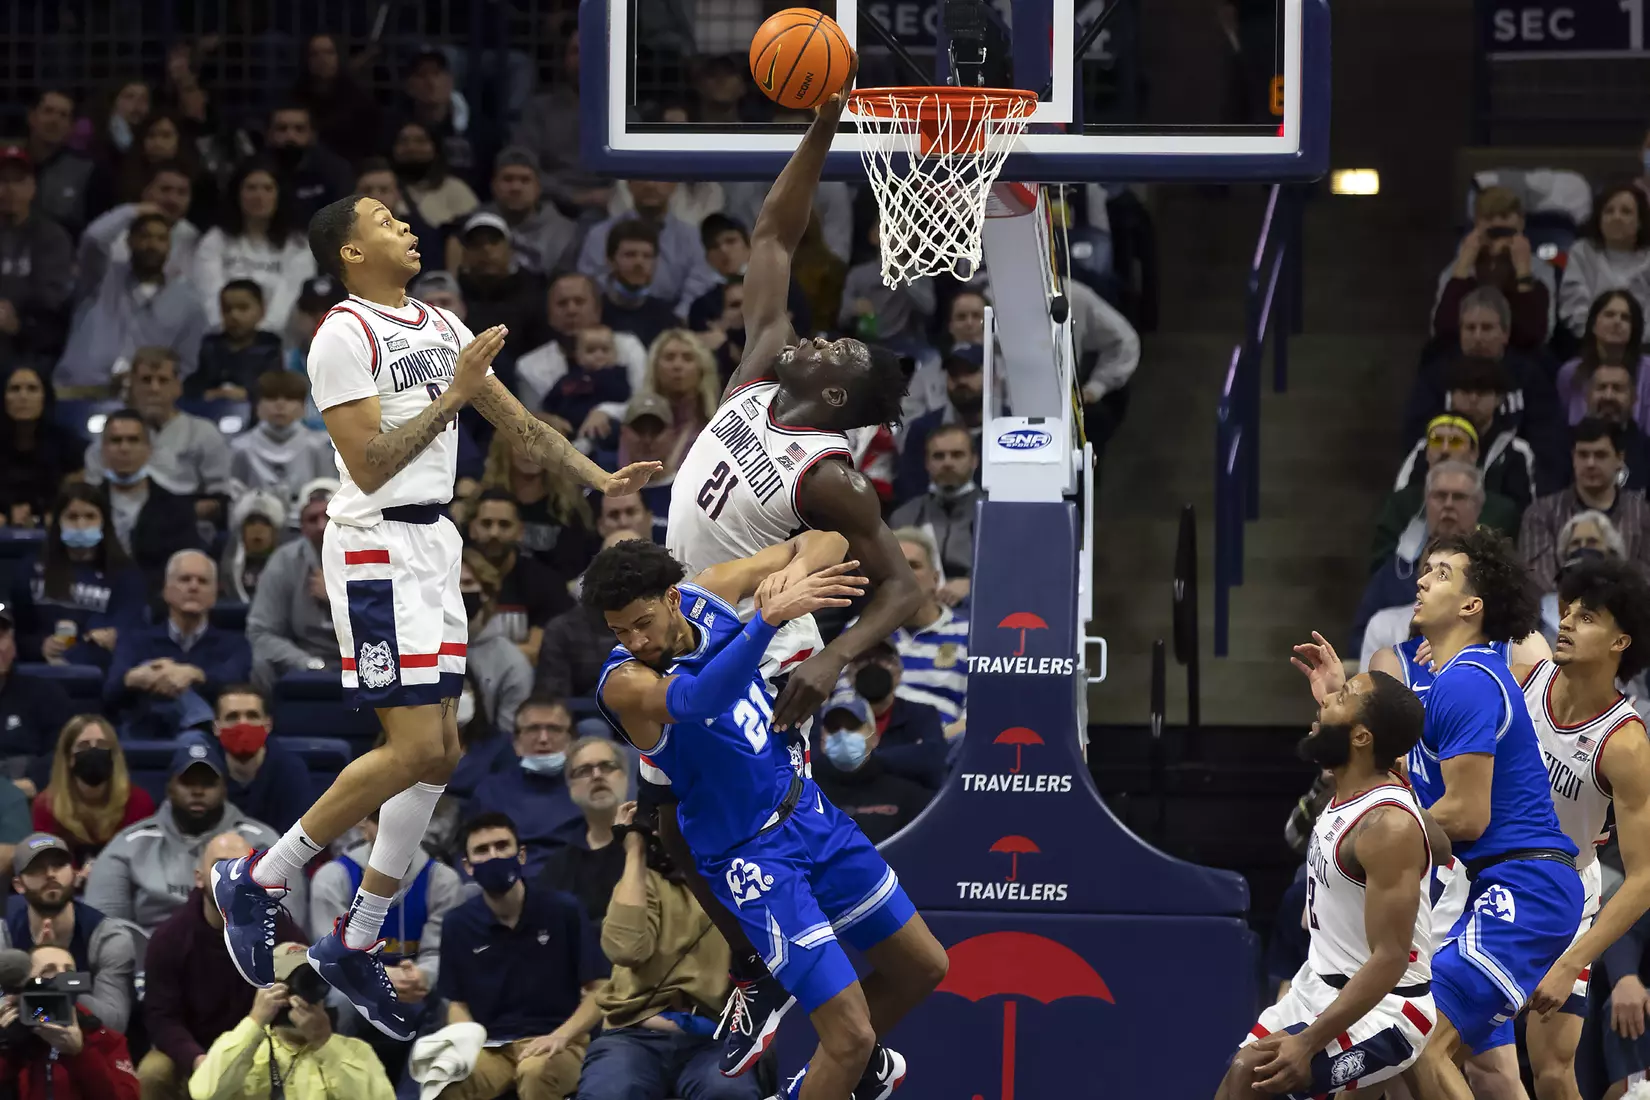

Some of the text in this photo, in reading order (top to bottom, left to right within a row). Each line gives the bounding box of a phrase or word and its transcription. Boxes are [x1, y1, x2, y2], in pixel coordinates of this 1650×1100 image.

[1493, 8, 1576, 42] SEC
[795, 72, 814, 100] UCONN
[710, 409, 785, 506] CONNECTICUT
[696, 460, 739, 521] 21
[967, 656, 1074, 675] TRAVELERS
[733, 681, 774, 754] 21
[961, 774, 1073, 792] TRAVELERS
[956, 882, 1068, 901] TRAVELERS
